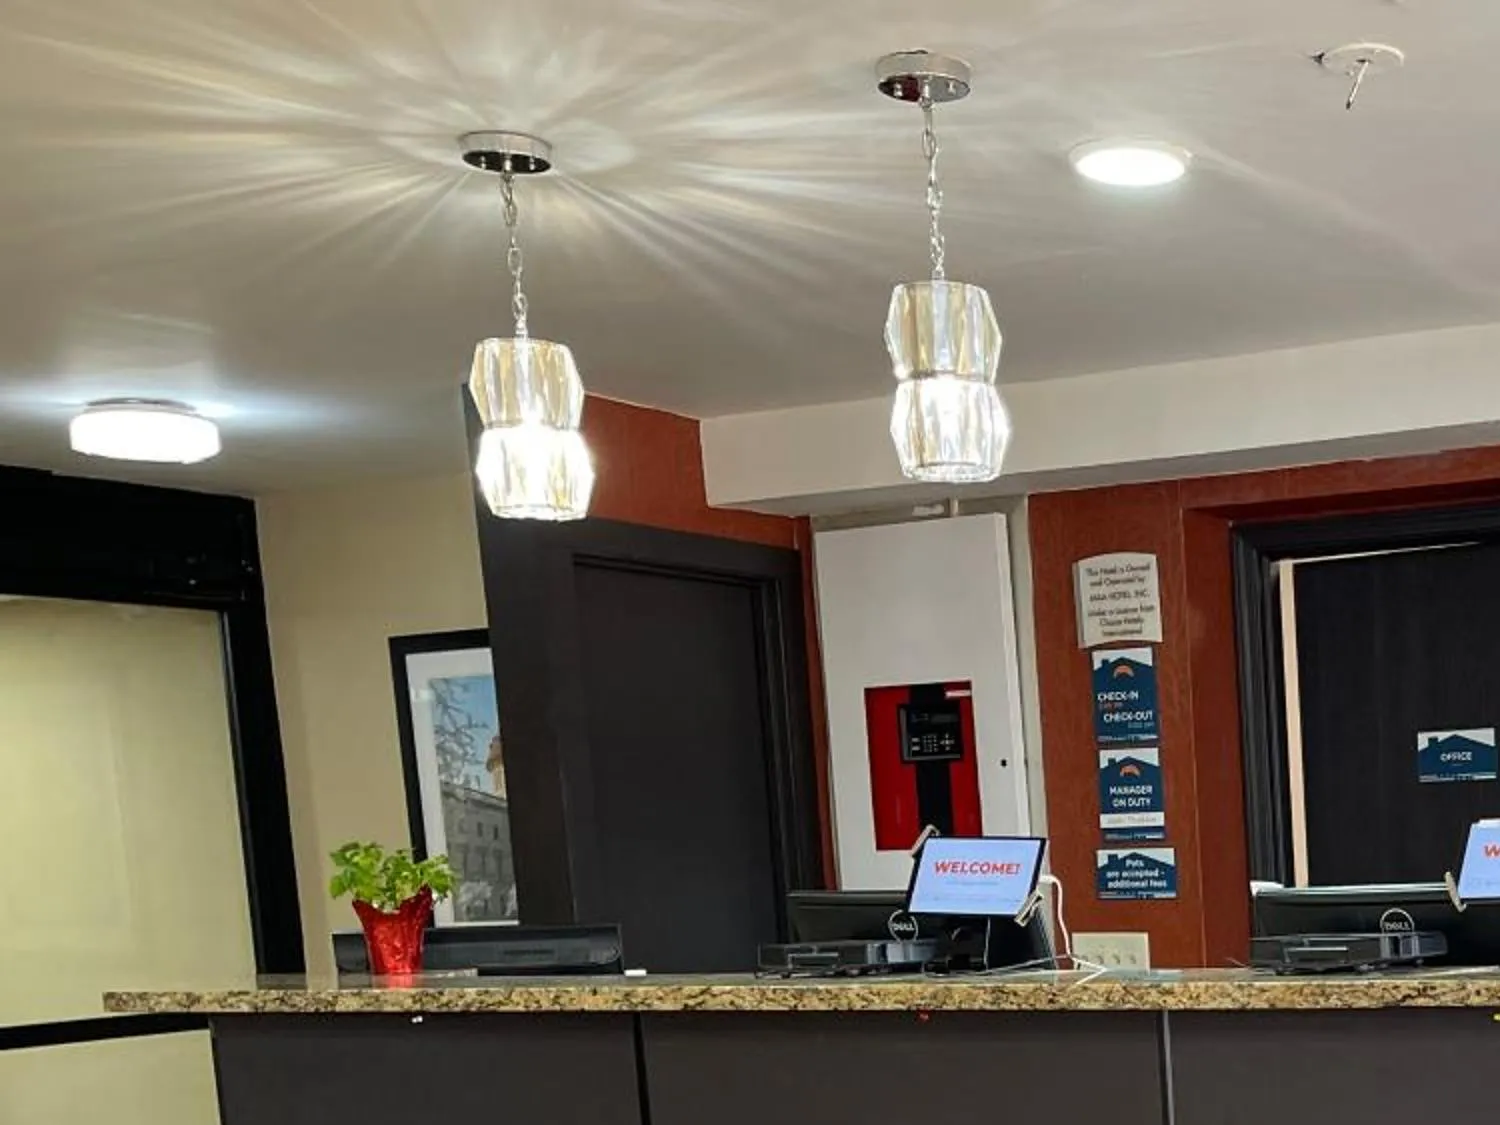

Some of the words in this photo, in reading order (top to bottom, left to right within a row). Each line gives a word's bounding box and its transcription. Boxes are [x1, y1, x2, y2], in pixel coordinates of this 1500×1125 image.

[1097, 690, 1139, 702] CHECK-IN
[1103, 710, 1153, 724] CHECK-OUT
[1440, 751, 1472, 762] OFFICE
[1109, 784, 1153, 795] MANAGER
[1112, 797, 1126, 807] ON
[1127, 797, 1152, 807] DUTY
[934, 860, 1021, 875] WELCOME!
[1125, 859, 1144, 868] Pets
[1106, 871, 1120, 879] are
[1121, 868, 1159, 879] accepted
[1107, 879, 1148, 889] additional
